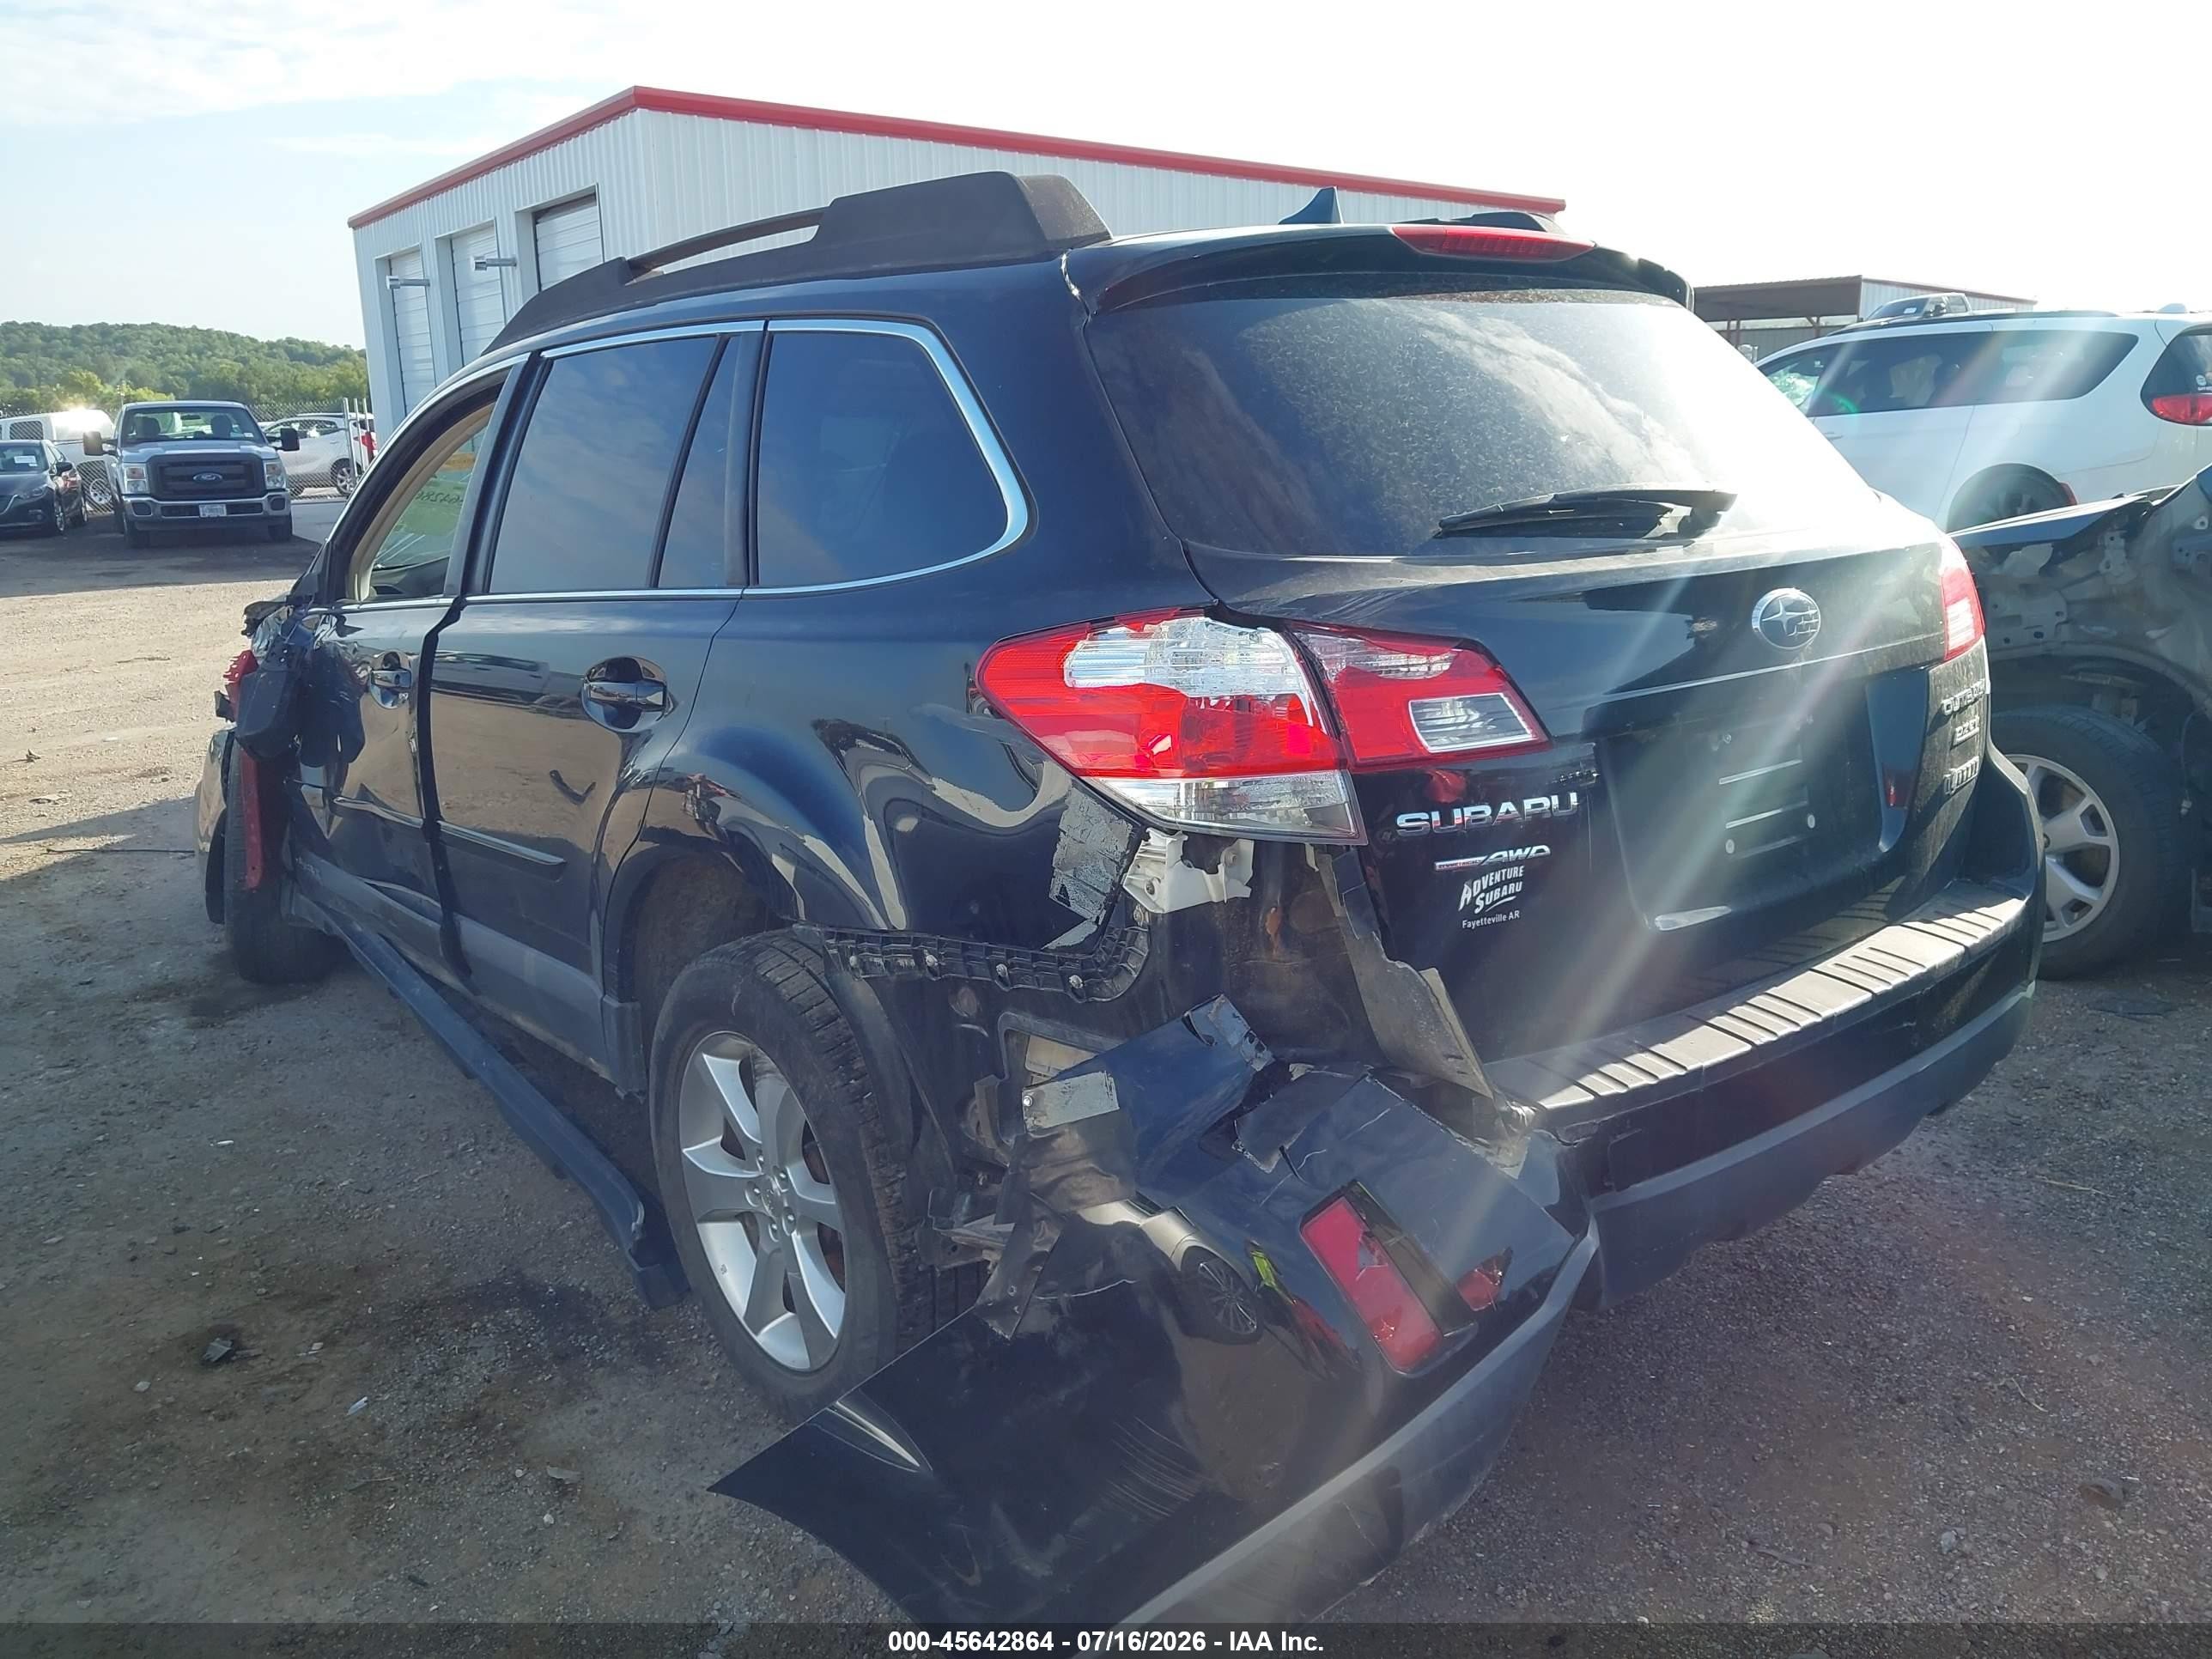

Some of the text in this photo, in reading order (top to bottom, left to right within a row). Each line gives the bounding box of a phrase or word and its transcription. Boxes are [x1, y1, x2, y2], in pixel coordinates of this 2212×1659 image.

[1941, 678, 1986, 716] OUTBA
[1395, 792, 1579, 837] SUBARU
[1480, 845, 1551, 866] AWD
[1458, 866, 1525, 911] ADVENTURE
[1474, 881, 1522, 915] SUBARU
[1462, 910, 1521, 930] Fayetteville AR
